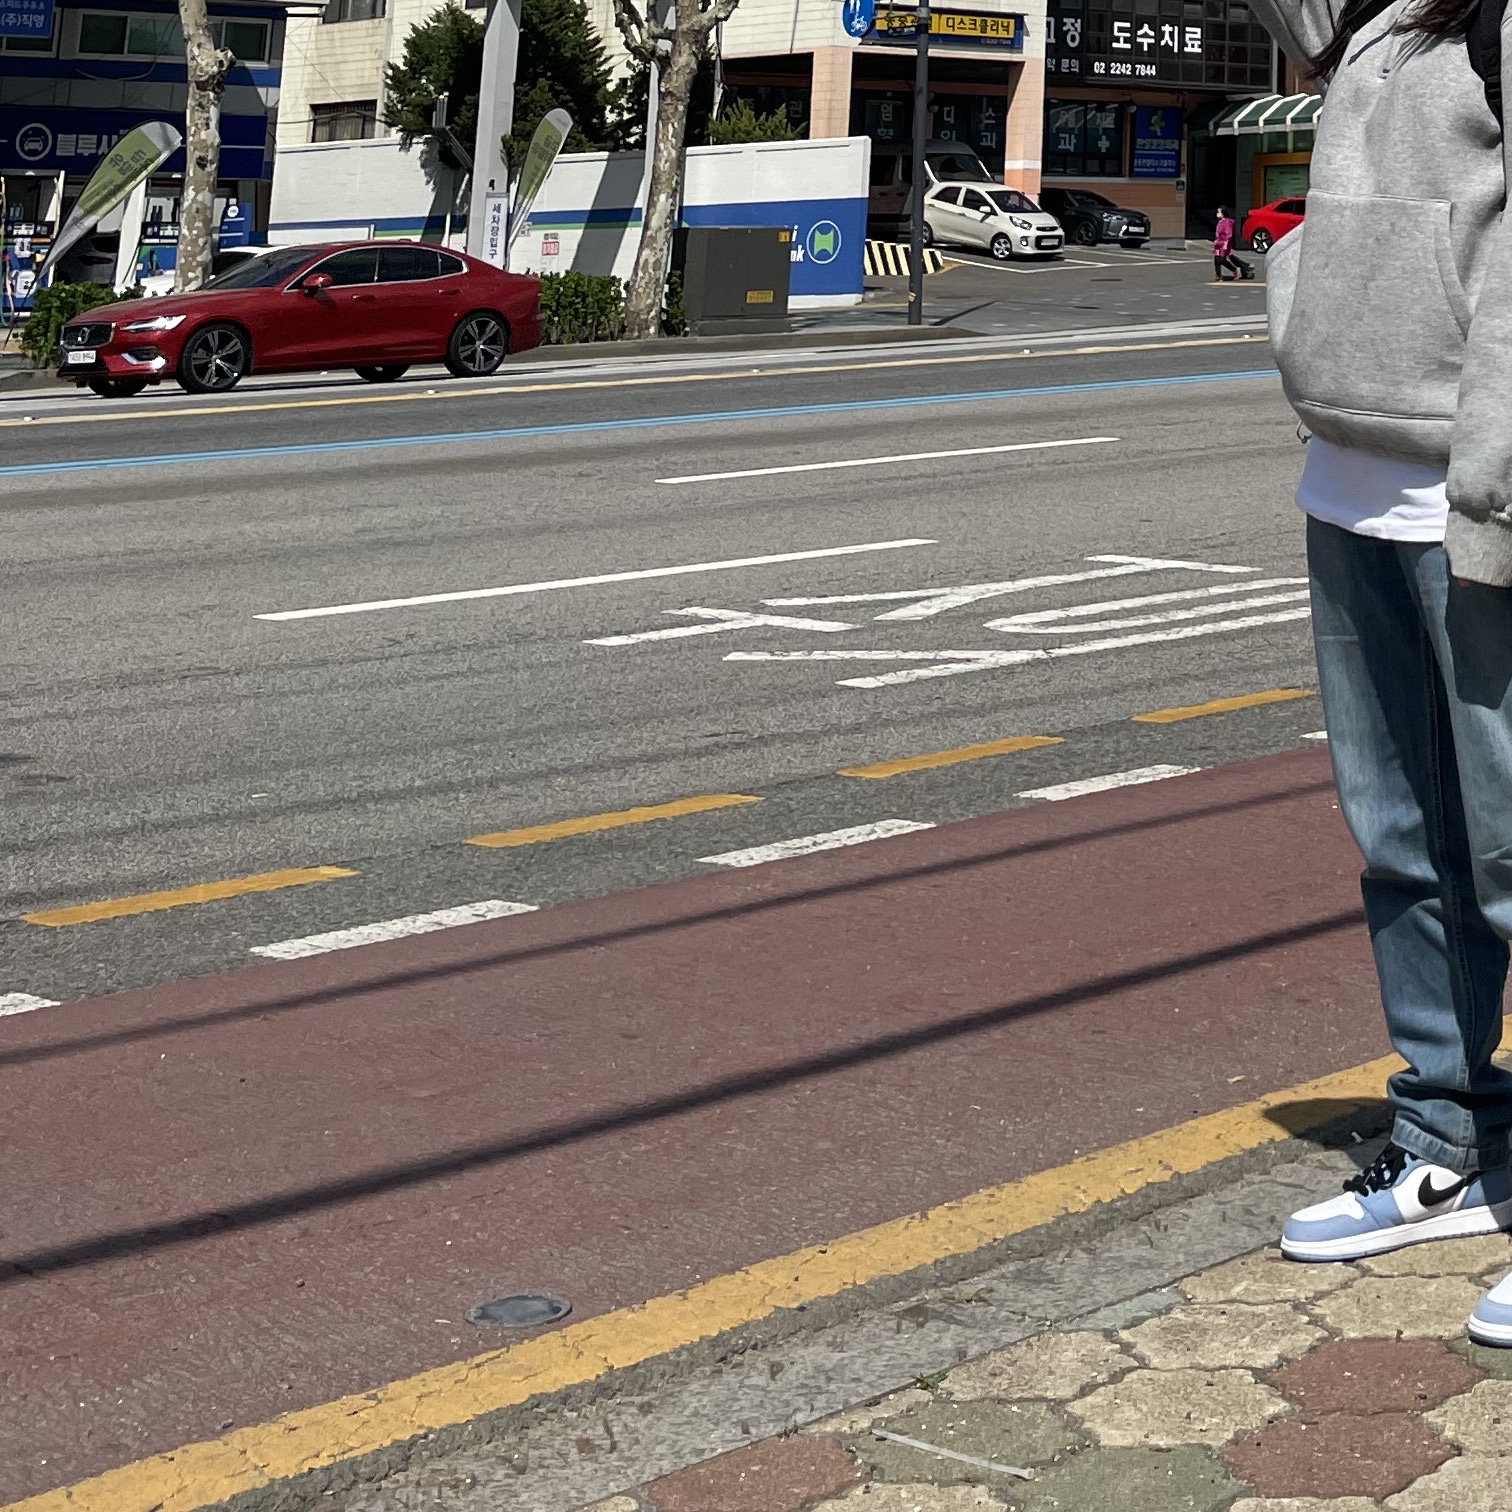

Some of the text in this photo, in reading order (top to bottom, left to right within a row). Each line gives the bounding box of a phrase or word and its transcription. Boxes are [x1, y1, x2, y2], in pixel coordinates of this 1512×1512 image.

[945, 17, 1011, 36] 디스크클리닉
[1111, 21, 1203, 53] 도수치료
[1094, 61, 1157, 76] 02 2242 7844
[489, 203, 502, 260] 세차장입구
